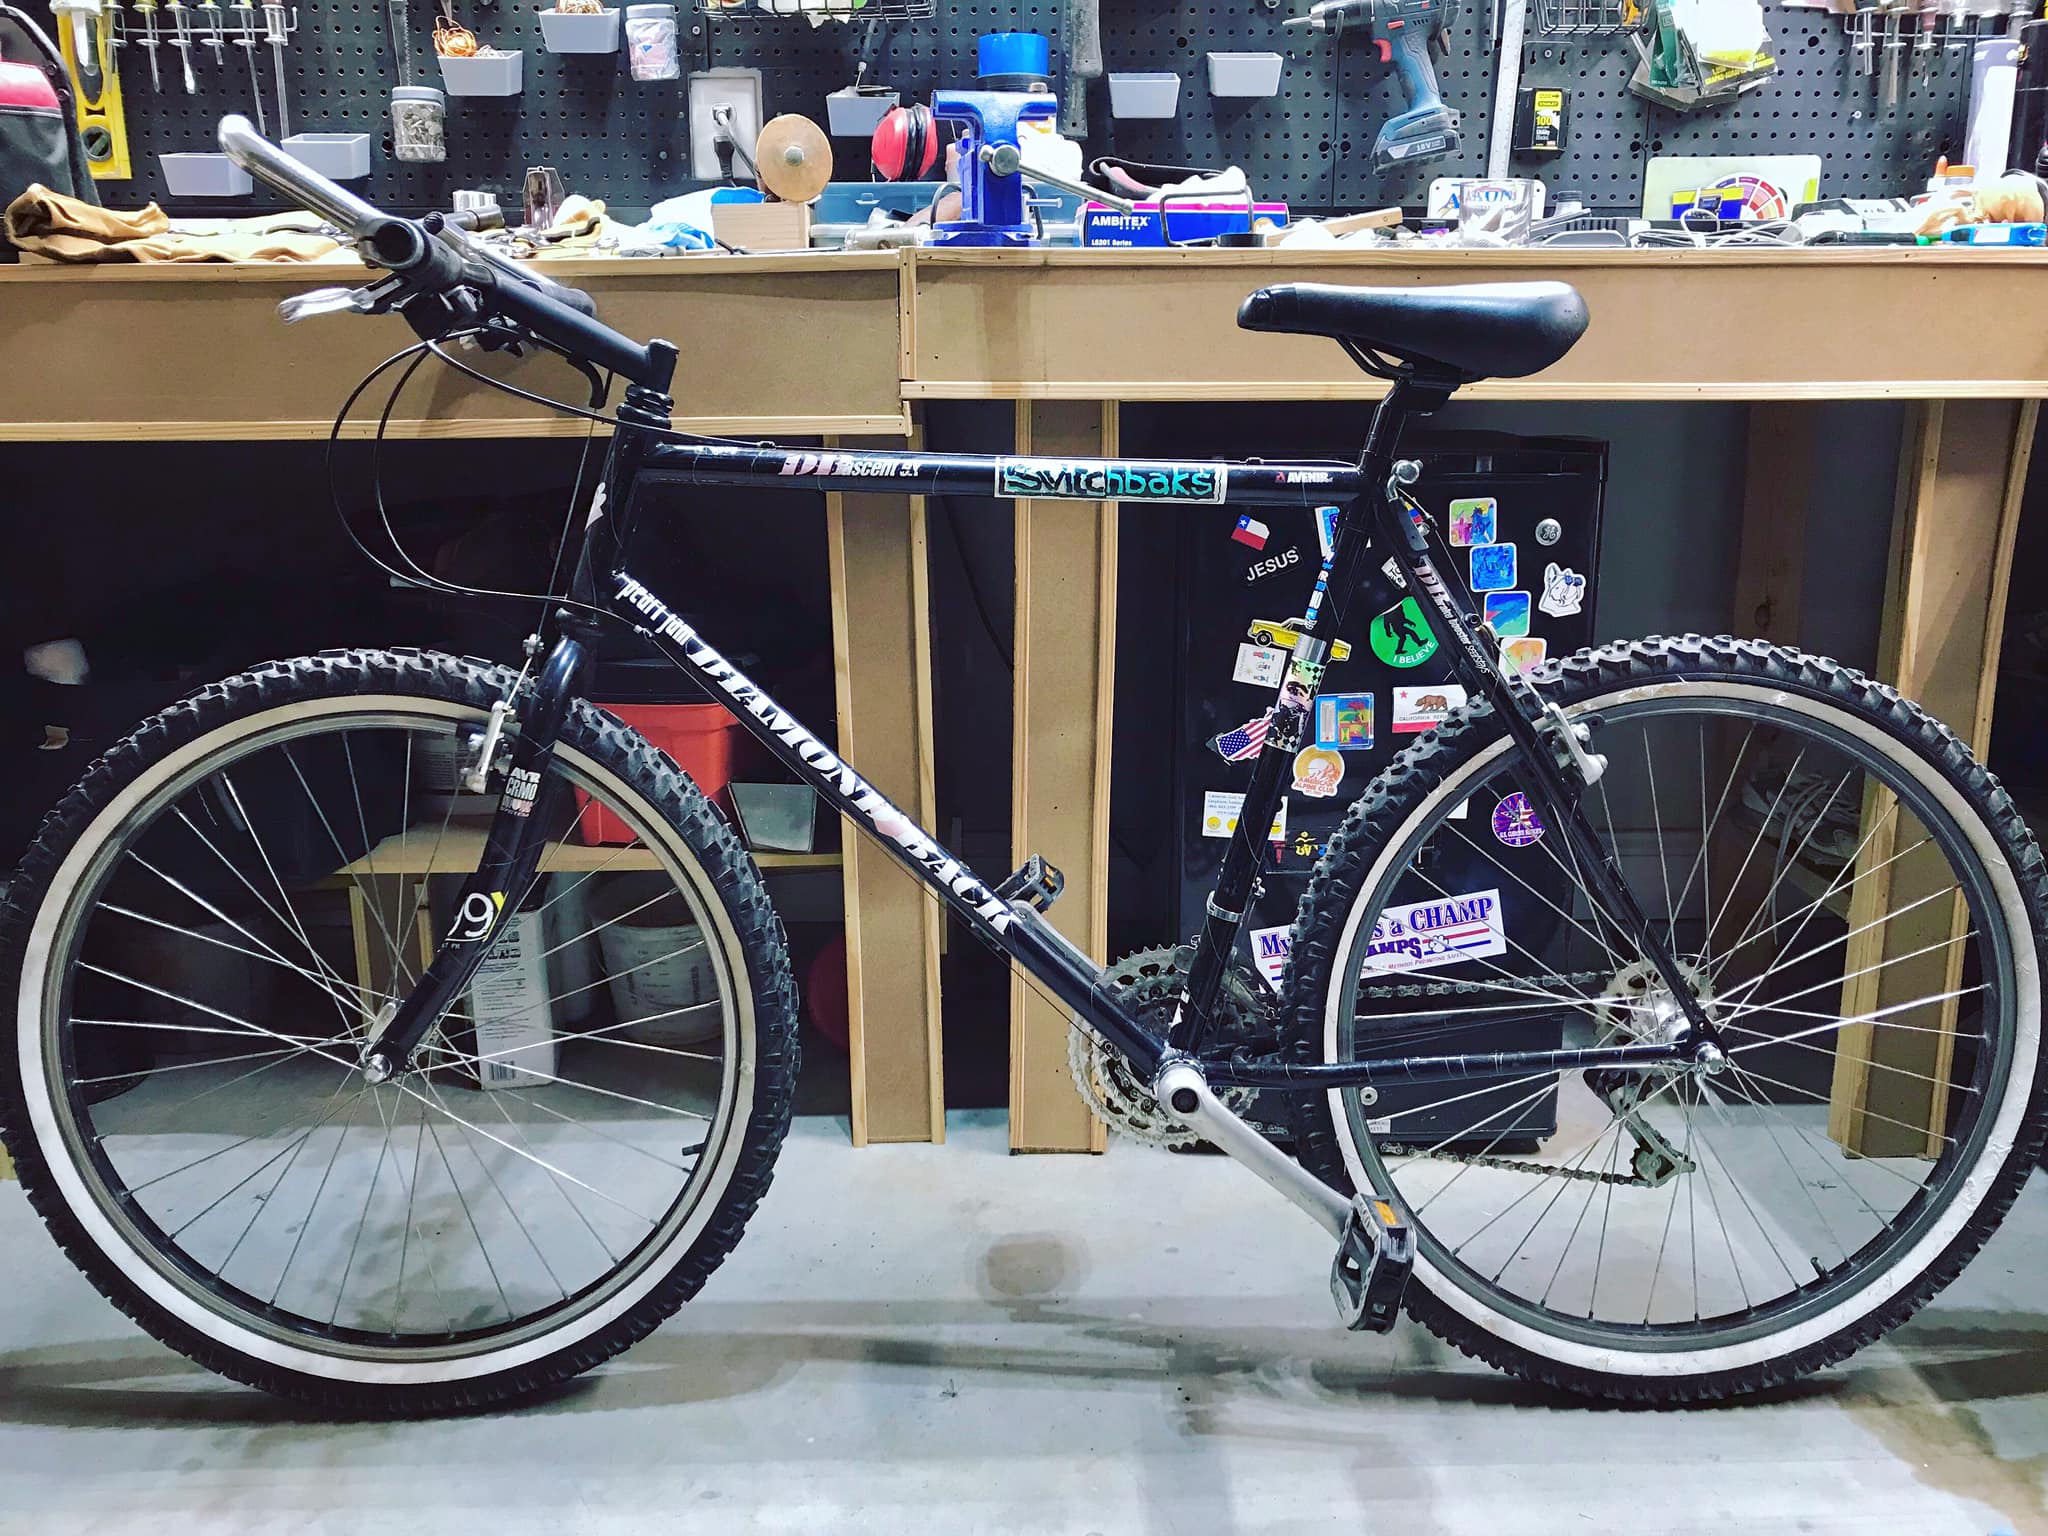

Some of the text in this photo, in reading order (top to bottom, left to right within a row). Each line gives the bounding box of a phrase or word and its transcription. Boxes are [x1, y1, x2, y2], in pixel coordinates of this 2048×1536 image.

[1091, 215, 1149, 227] AMBITEX
[1246, 549, 1300, 582] JESUS
[654, 612, 697, 646] jam
[1398, 640, 1436, 664] BELIEVE
[510, 766, 541, 784] AVR
[505, 777, 538, 801] CRMO
[1259, 931, 1293, 958] My
[1390, 919, 1405, 937] a
[1409, 896, 1494, 933] CHAMP
[1366, 937, 1423, 959] AMPS
